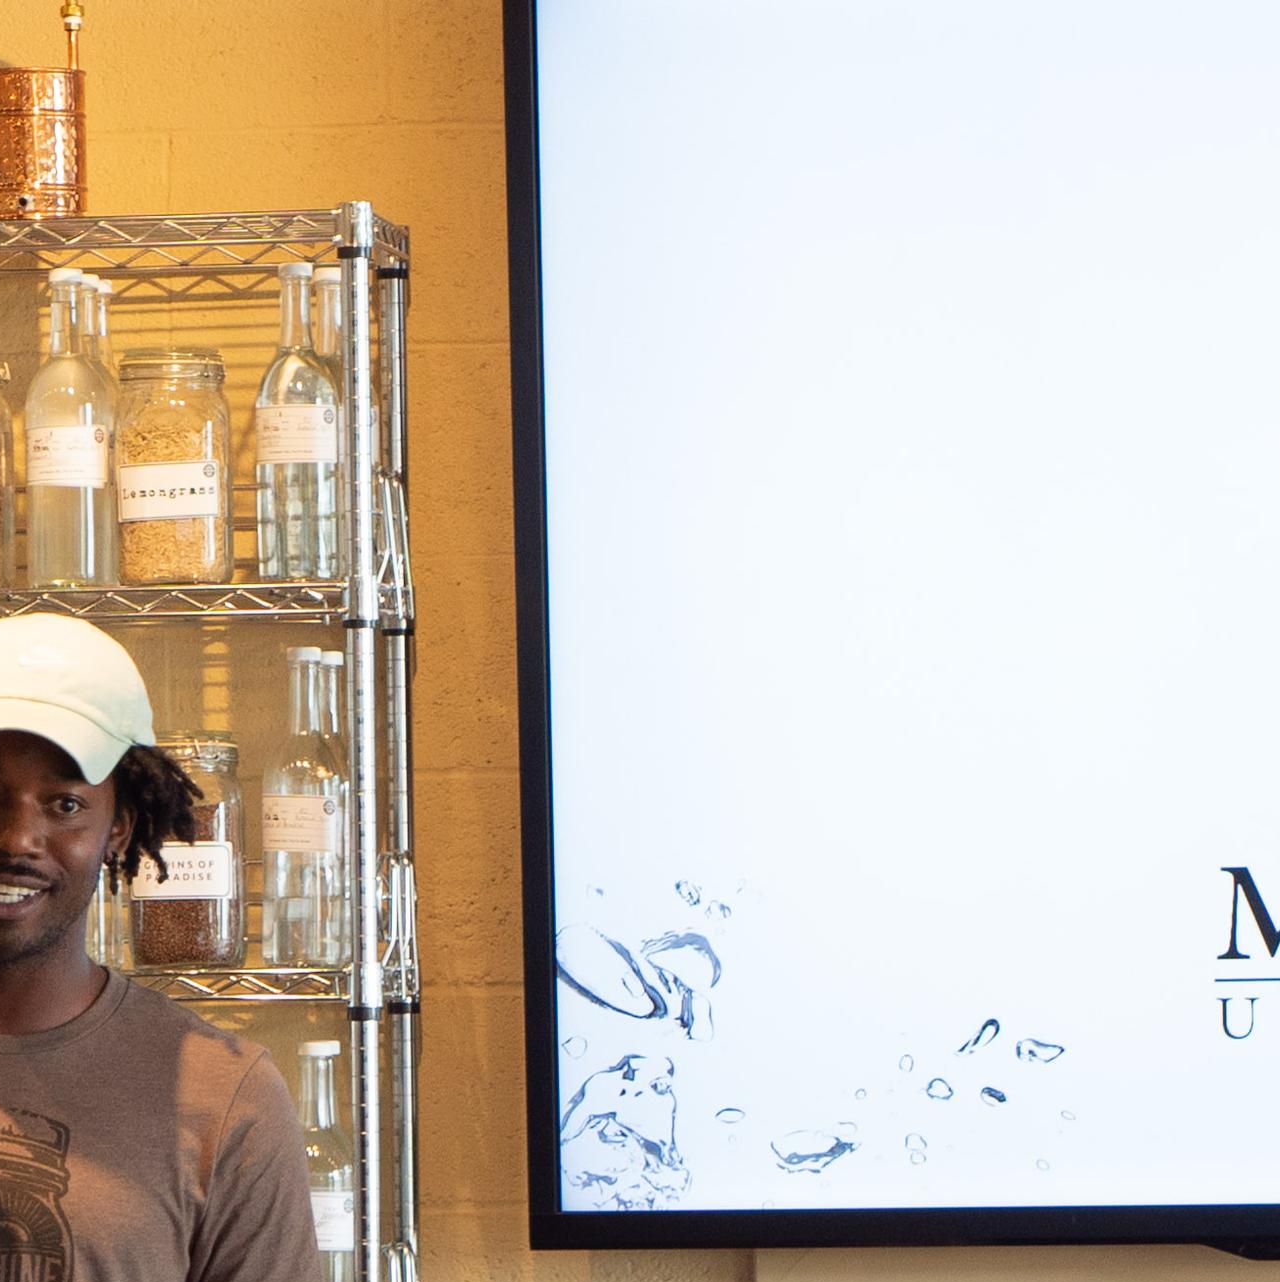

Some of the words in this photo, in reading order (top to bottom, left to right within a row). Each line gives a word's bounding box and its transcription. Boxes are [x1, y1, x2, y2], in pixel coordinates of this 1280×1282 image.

[123, 487, 215, 500] Lemongrass
[144, 861, 193, 870] GINS
[198, 861, 215, 869] OF
[146, 873, 213, 881] PAADISE
